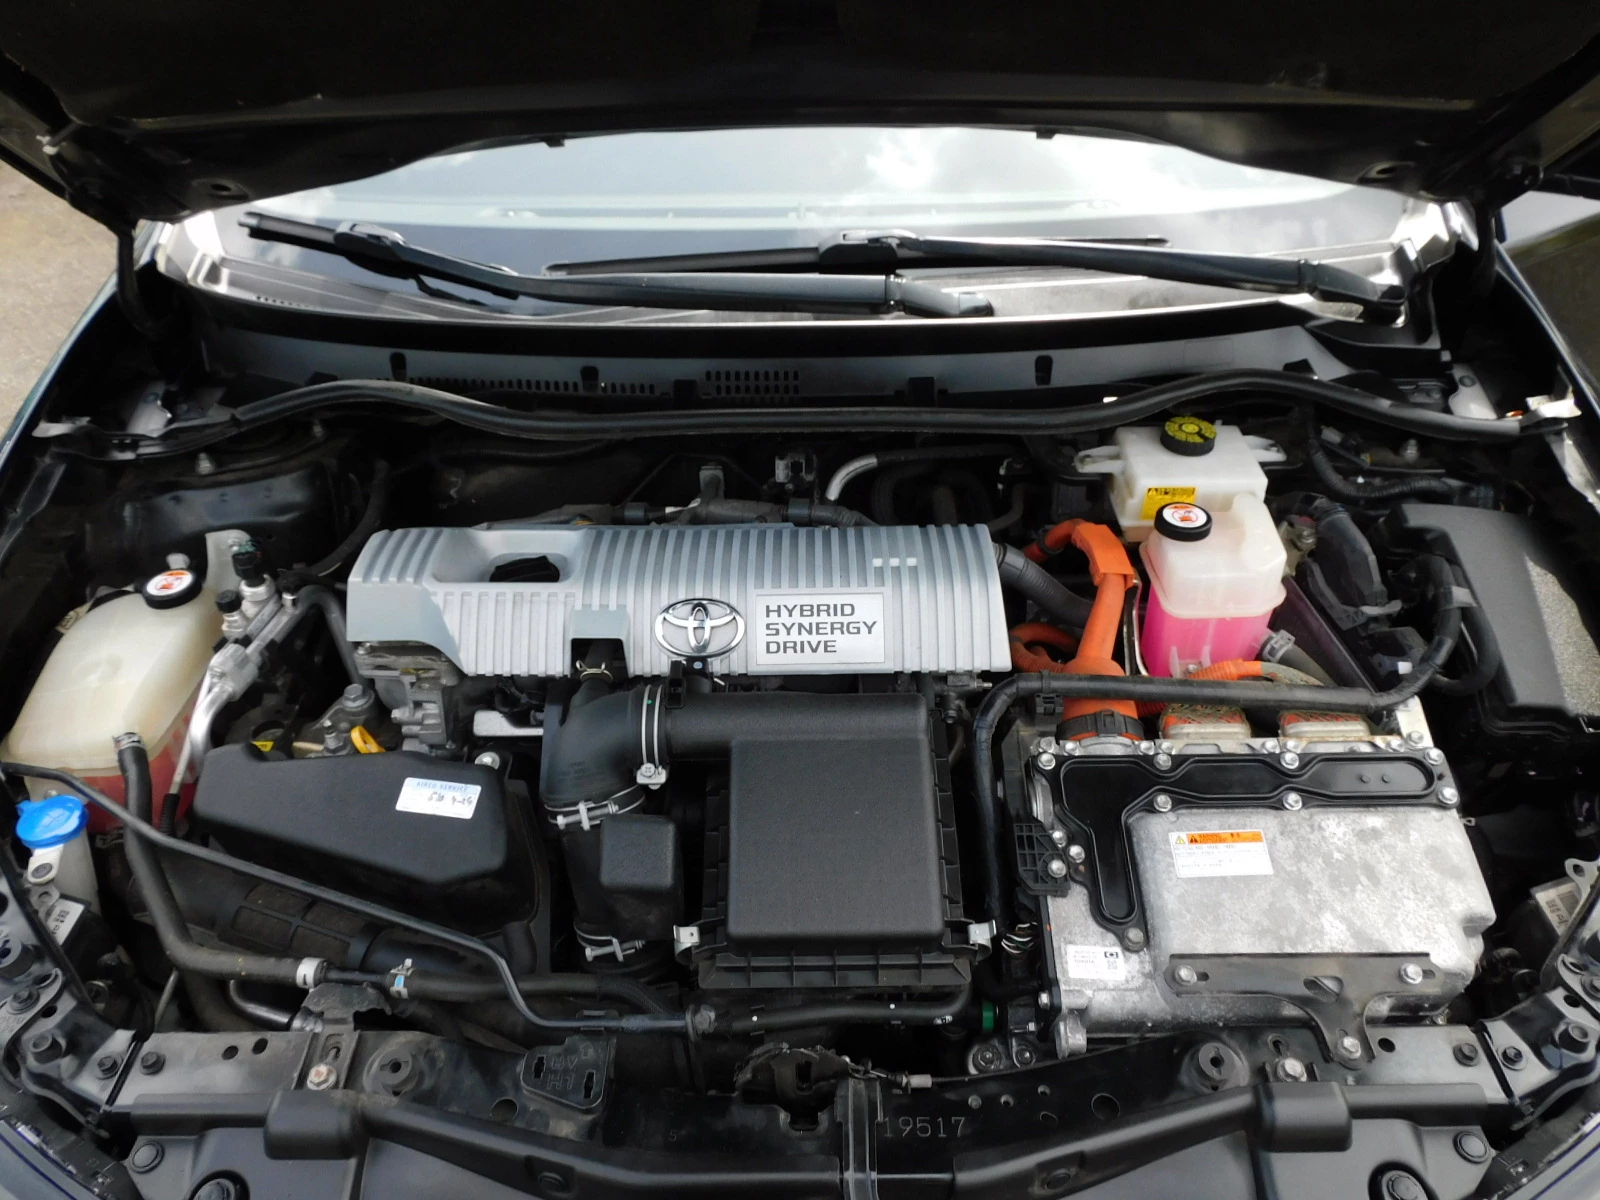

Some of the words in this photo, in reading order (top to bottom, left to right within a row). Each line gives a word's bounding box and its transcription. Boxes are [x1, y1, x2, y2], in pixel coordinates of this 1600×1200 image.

[765, 603, 856, 618] HYBRID
[765, 621, 878, 636] SYNERGY
[765, 640, 838, 654] DRIVE
[439, 784, 468, 792] SERVICE
[883, 1116, 966, 1138] 19517
